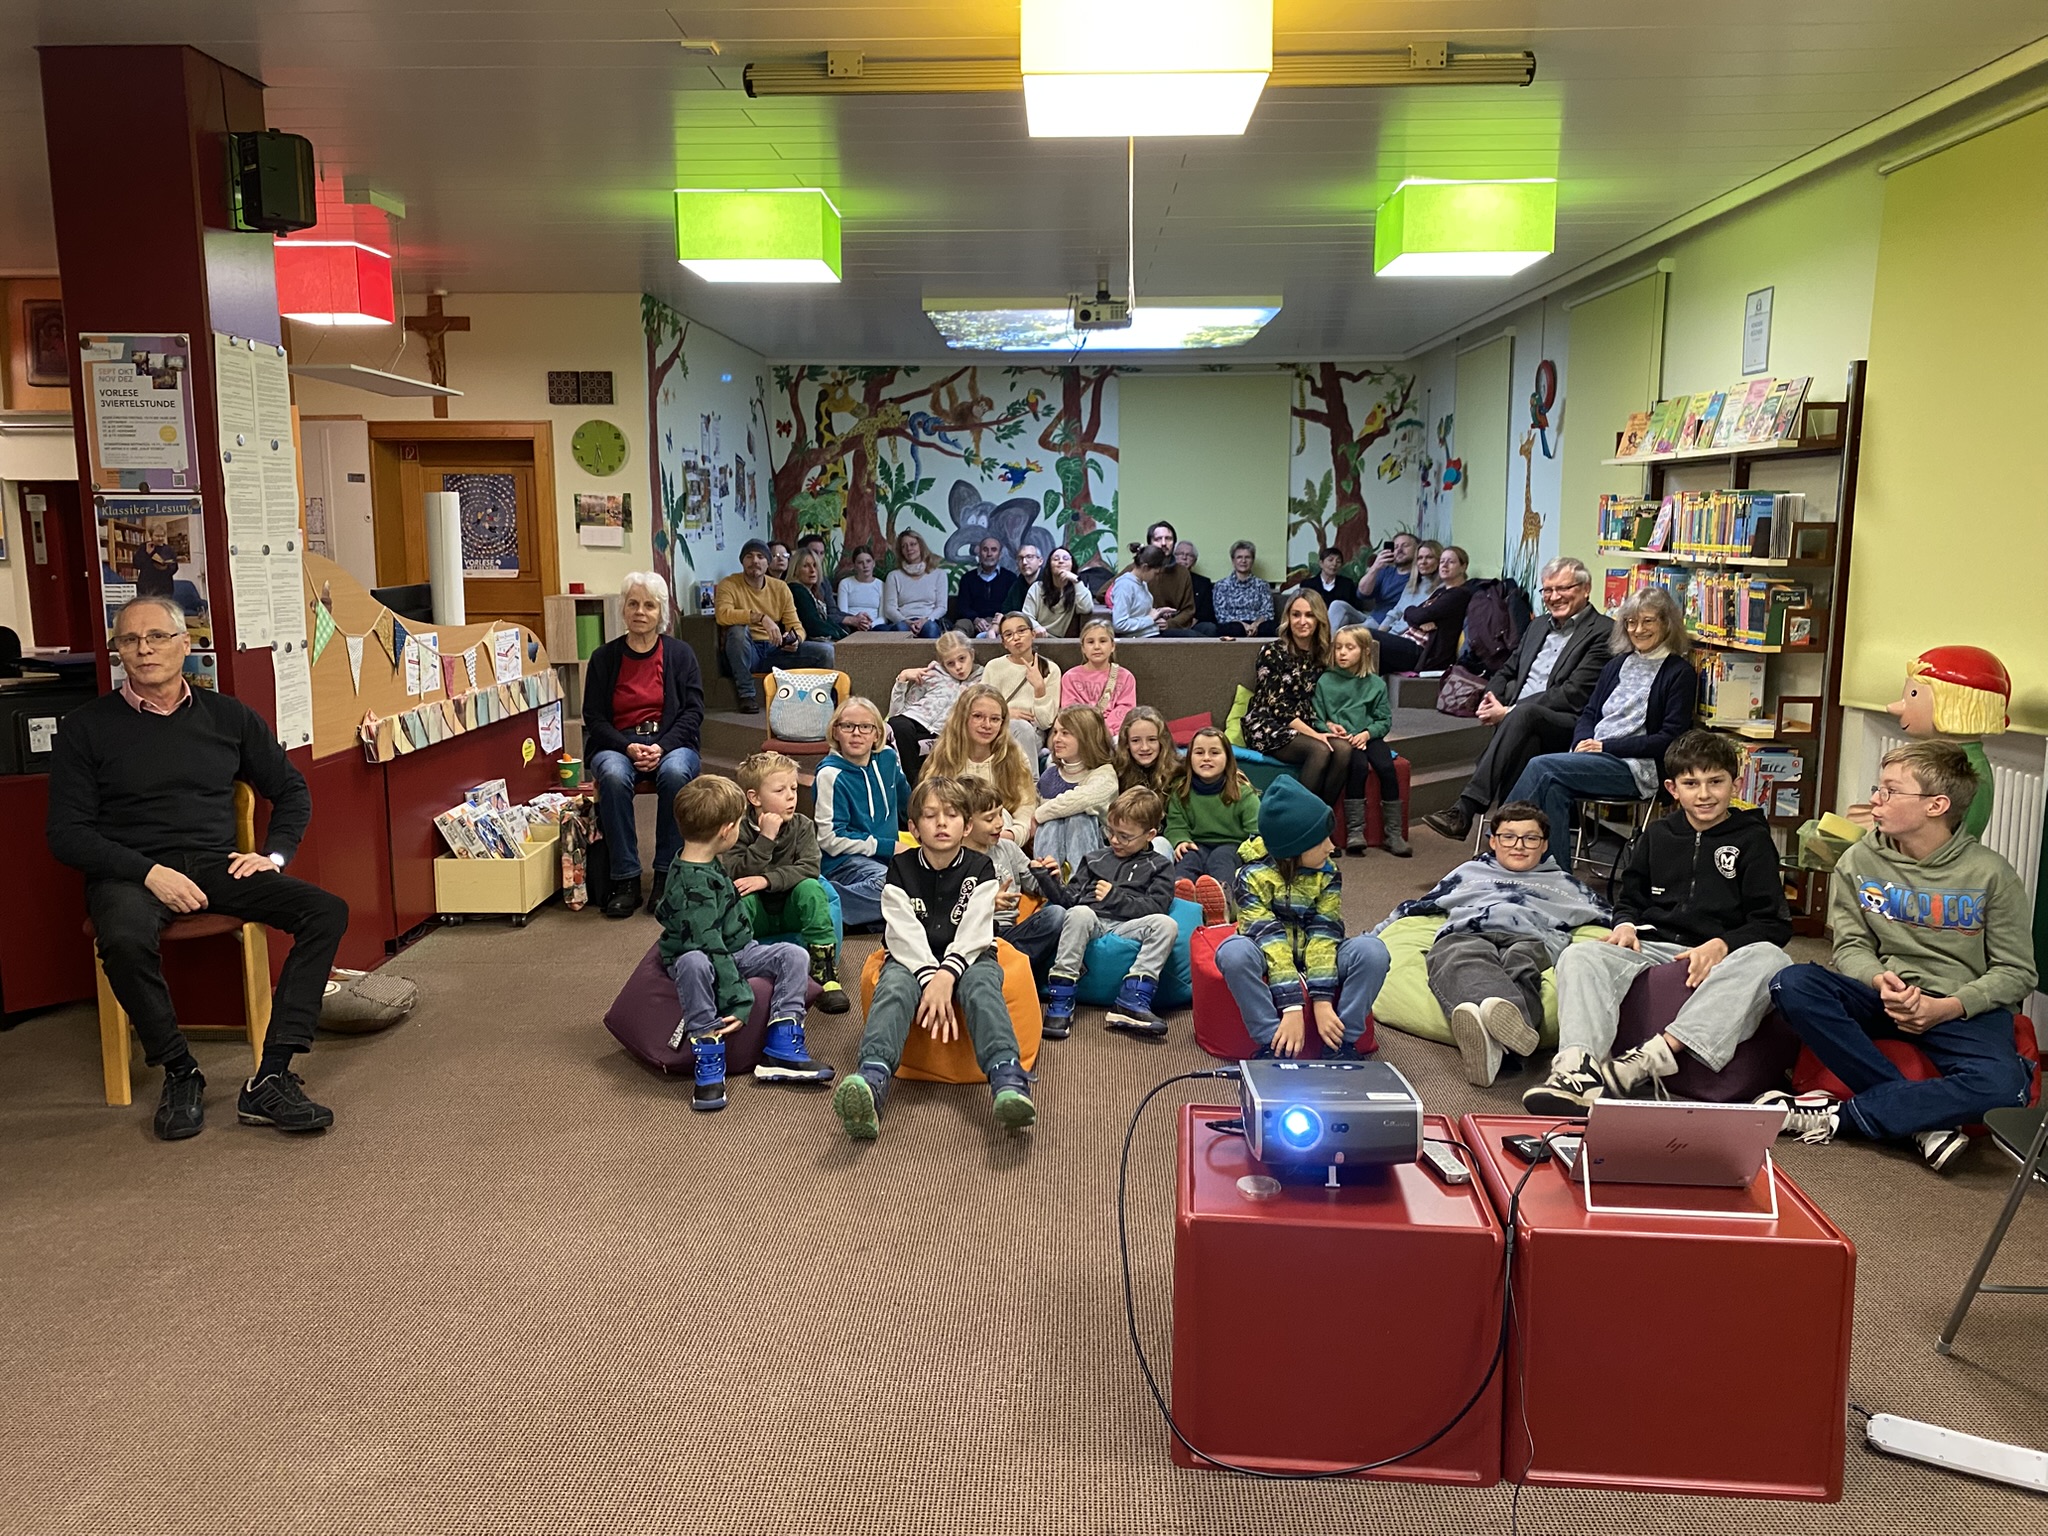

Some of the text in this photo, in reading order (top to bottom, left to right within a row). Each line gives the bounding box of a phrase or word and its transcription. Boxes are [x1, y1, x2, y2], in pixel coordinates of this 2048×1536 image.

[99, 389, 139, 397] VORLESE
[101, 400, 176, 408] 3VIERTELSTUNDE
[101, 503, 193, 516] Klassiker-Lesung
[1917, 891, 1986, 928] PIECE
